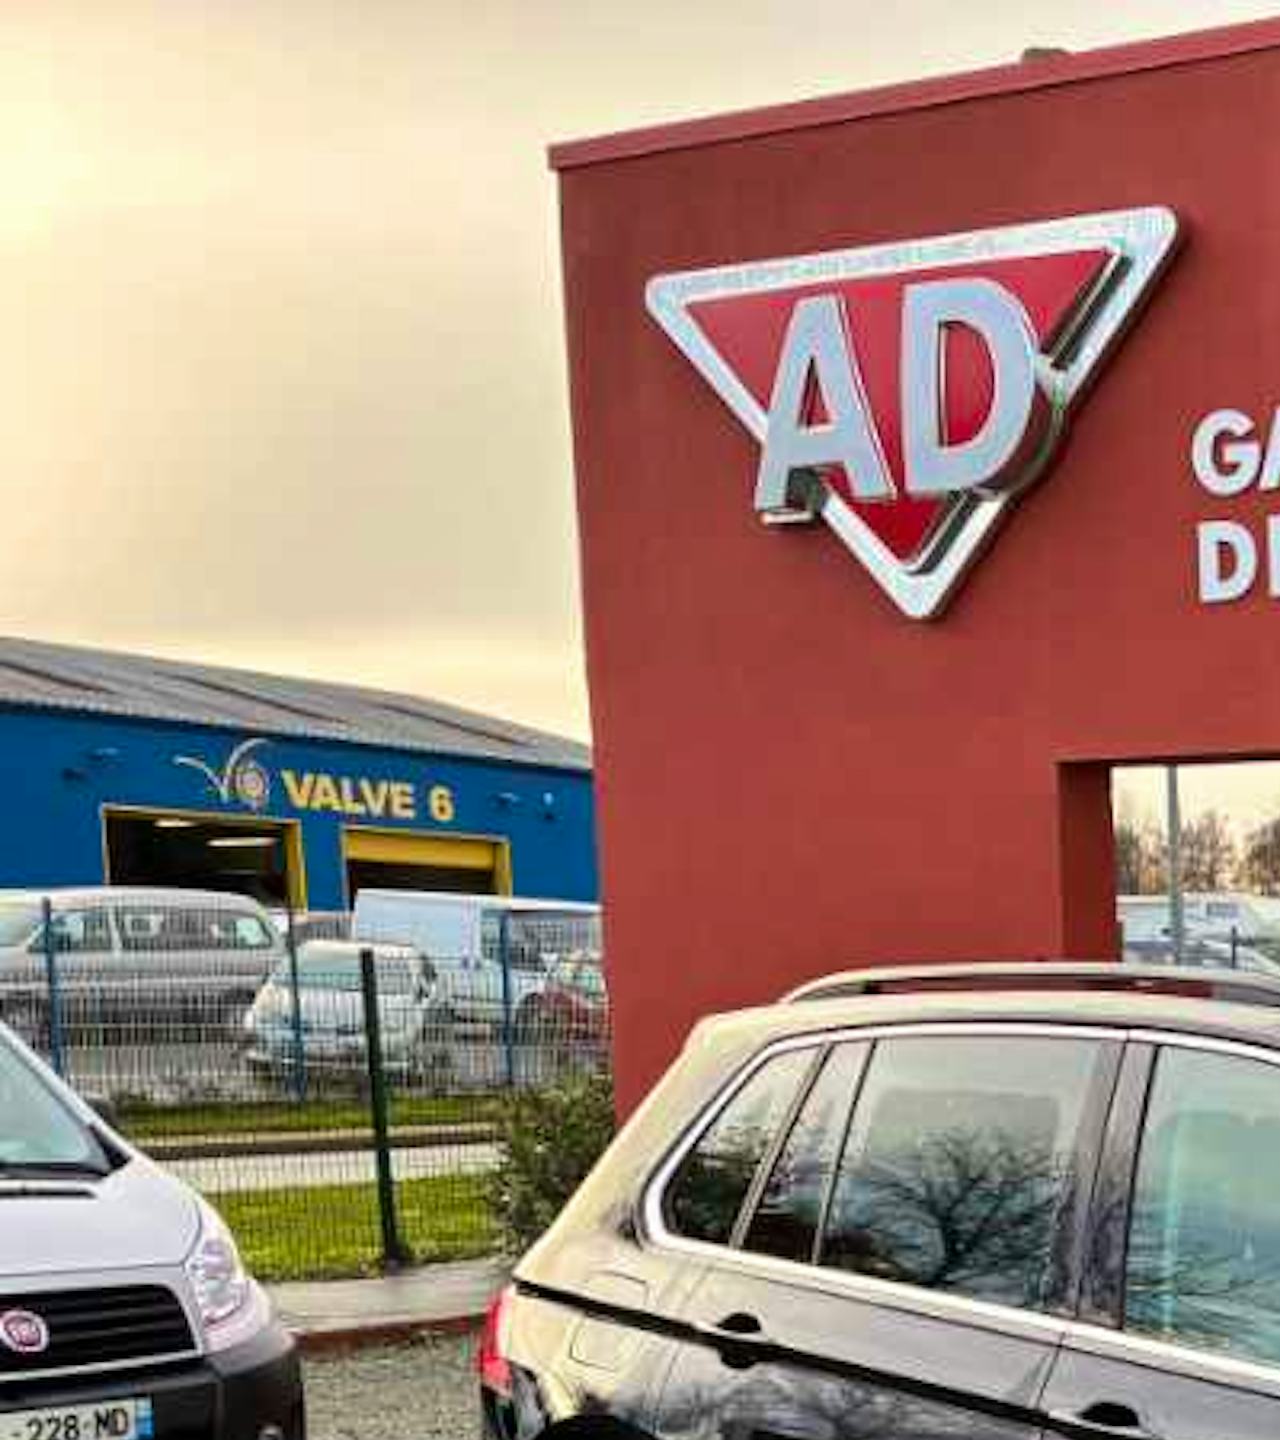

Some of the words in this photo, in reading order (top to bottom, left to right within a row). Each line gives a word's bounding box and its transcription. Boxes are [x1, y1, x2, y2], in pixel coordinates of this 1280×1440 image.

[754, 279, 1040, 520] AD
[280, 769, 417, 820] VALVE
[428, 785, 455, 823] 6
